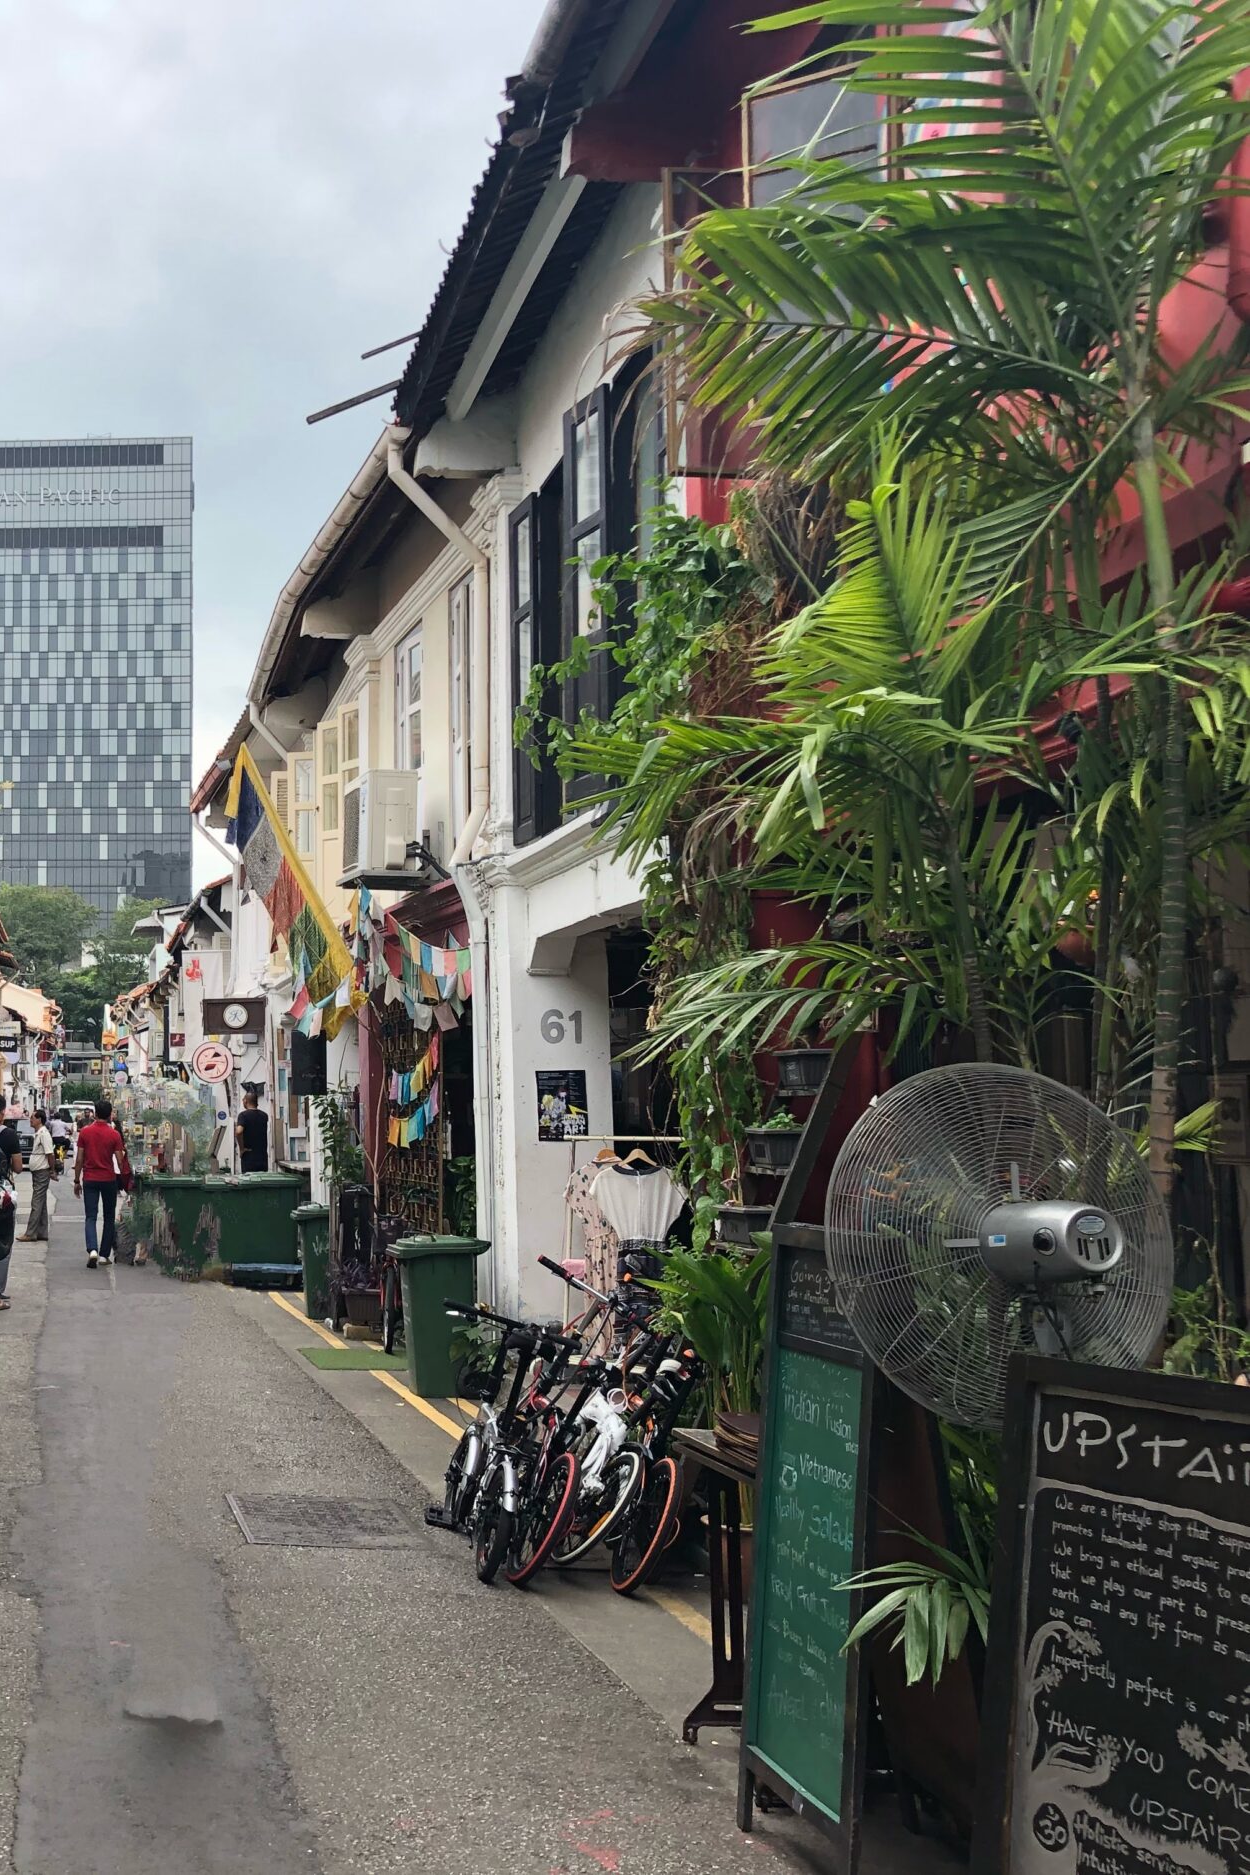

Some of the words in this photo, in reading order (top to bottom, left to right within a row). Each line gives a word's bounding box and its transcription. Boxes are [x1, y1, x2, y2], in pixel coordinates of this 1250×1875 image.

[39, 486, 122, 506] PACIFIC
[0, 1040, 16, 1049] SUP
[541, 1009, 582, 1044] 61
[800, 1453, 853, 1490] Vietnamese
[1055, 1494, 1074, 1511] We
[1080, 1502, 1096, 1514] are
[1101, 1507, 1107, 1517] a
[1112, 1504, 1152, 1531] lifestyle
[1158, 1515, 1182, 1541] shop
[1187, 1521, 1211, 1541] that
[1052, 1521, 1093, 1537] promotes
[1101, 1529, 1148, 1552] handmade
[1154, 1544, 1173, 1558] and
[1181, 1554, 1220, 1570] organic
[1050, 1561, 1071, 1580] that
[1081, 1575, 1096, 1586] we
[1103, 1577, 1126, 1597] play
[1133, 1588, 1152, 1600] our
[1159, 1595, 1186, 1613] part
[1194, 1602, 1208, 1618] to
[1054, 1541, 1072, 1557] We
[1080, 1545, 1103, 1570] bring
[1110, 1556, 1120, 1569] in
[1126, 1561, 1163, 1580] ethical
[1172, 1574, 1208, 1593] goods
[1217, 1583, 1231, 1599] to
[1049, 1606, 1065, 1619] we
[1052, 1587, 1080, 1604] earth
[1090, 1599, 1111, 1614] and
[1119, 1608, 1138, 1626] any
[1147, 1612, 1166, 1640] life
[1174, 1620, 1203, 1648] form
[1213, 1640, 1229, 1656] as
[1051, 1644, 1116, 1689] Imperfectly
[1126, 1677, 1175, 1706] perfect
[1185, 1697, 1197, 1712] is
[1208, 1710, 1229, 1724] our
[1122, 1737, 1164, 1773] YOU
[1073, 1813, 1130, 1856] Holistic
